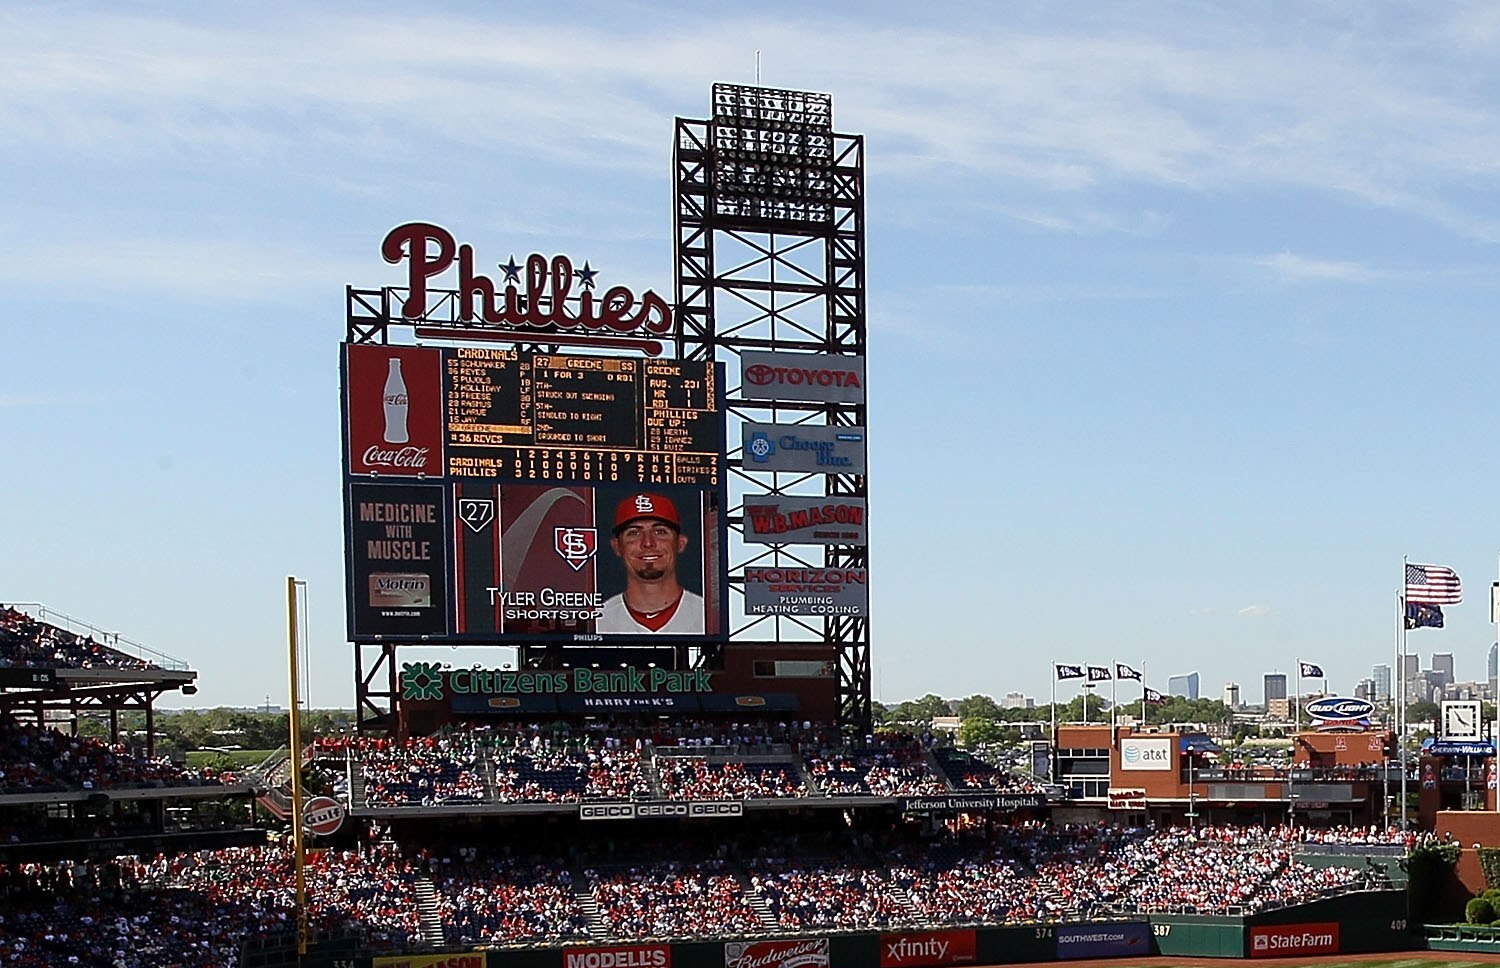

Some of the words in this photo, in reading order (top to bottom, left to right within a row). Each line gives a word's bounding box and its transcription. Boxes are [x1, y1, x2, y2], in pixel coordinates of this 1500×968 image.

[381, 222, 673, 334] Phillies
[457, 348, 518, 360] CARDINALS
[460, 360, 506, 368] SCHUMAKER
[536, 358, 548, 366] 27
[568, 360, 602, 368] GREENE
[622, 362, 632, 370] SS
[648, 366, 680, 376] GREENE
[650, 380, 671, 388] AVG.
[680, 380, 700, 388] .231
[774, 368, 860, 388] TOYOTA
[654, 390, 666, 398] HR
[654, 410, 698, 420] PHILLIES
[648, 418, 664, 426] DUE
[460, 434, 471, 443] 36
[474, 435, 503, 444] REYES
[780, 435, 835, 452] Choose
[362, 445, 430, 468] Coca-Cola
[450, 458, 502, 468] CARDINALS
[450, 467, 497, 477] PHILLIES
[651, 475, 662, 483] 14
[466, 502, 489, 520] 27
[368, 540, 430, 560] MUSCLE
[746, 570, 866, 584] HORIZON
[376, 578, 424, 590] Motrin
[768, 584, 841, 592] SERVICES
[506, 610, 604, 620] SHORTSTOP
[753, 605, 798, 613] HEATING
[811, 606, 860, 614] COOLING
[450, 670, 568, 693] Citizens
[574, 666, 646, 693] Bank
[650, 668, 712, 693] Park
[584, 698, 630, 706] HARRY
[1142, 748, 1167, 760] at&t
[905, 798, 945, 810] Jefferson
[948, 798, 993, 810] University
[996, 796, 1038, 808] Hospitals
[582, 806, 632, 816] GEICO
[638, 805, 687, 816] GEICO
[692, 804, 741, 815] GEICO
[305, 808, 340, 825] Gulf
[1153, 925, 1171, 936] 387
[1390, 920, 1407, 930] 409
[1036, 928, 1052, 939] 374
[1058, 934, 1124, 944] SOUTHWEST.COM
[888, 938, 948, 960] xfinity
